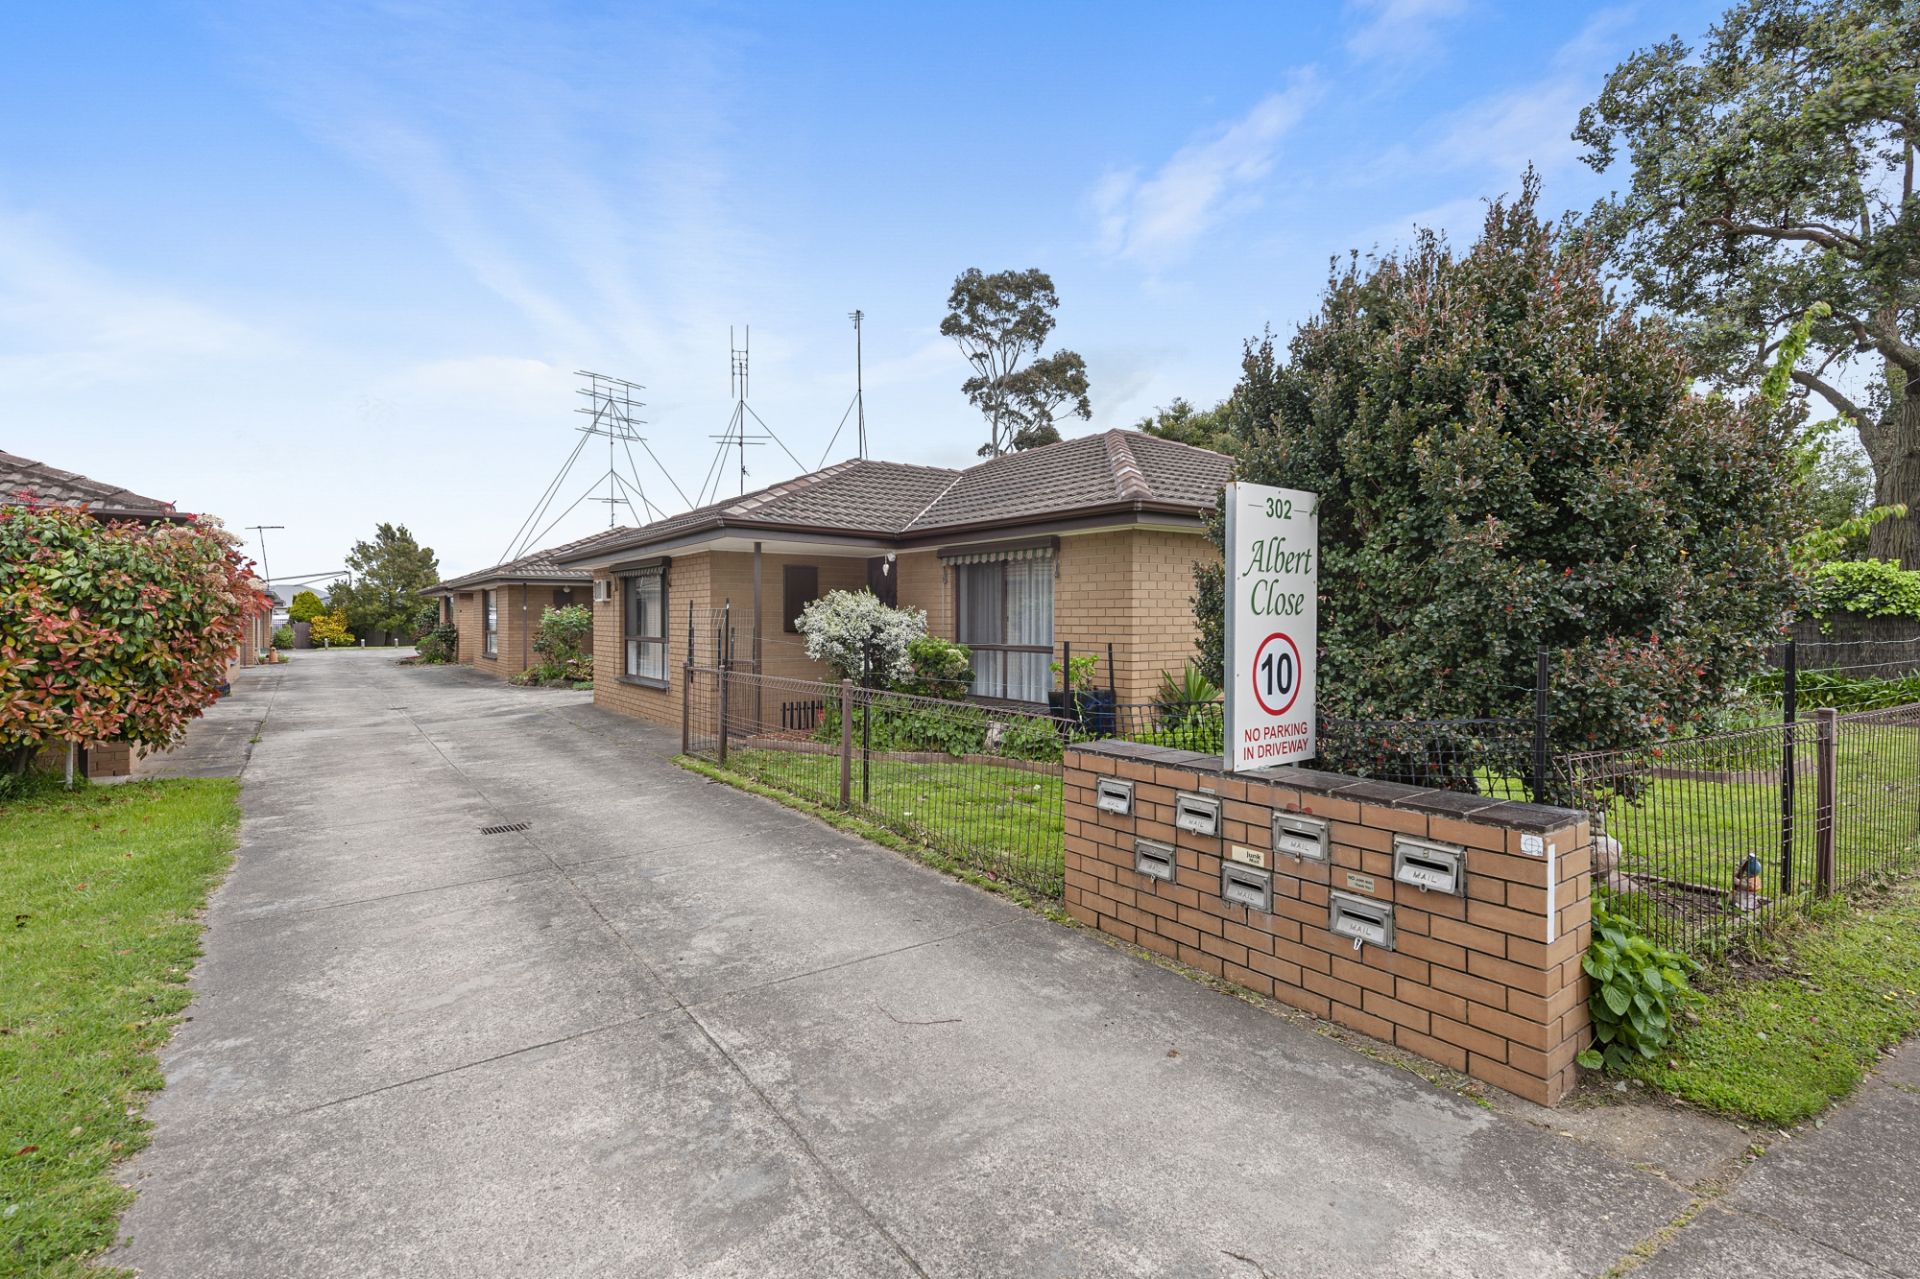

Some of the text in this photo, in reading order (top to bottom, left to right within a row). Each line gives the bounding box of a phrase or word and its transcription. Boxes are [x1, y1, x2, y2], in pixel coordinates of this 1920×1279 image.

[1266, 497, 1292, 519] 302
[1242, 536, 1312, 577] Albert
[1251, 579, 1304, 616] Close
[1261, 653, 1292, 696] 10
[1244, 722, 1308, 742] NO PARKING
[1243, 738, 1309, 760] IN DRIVEWAY
[1412, 871, 1437, 884] MAIL
[1237, 890, 1255, 901] MAIL
[1350, 922, 1372, 936] MAIL
